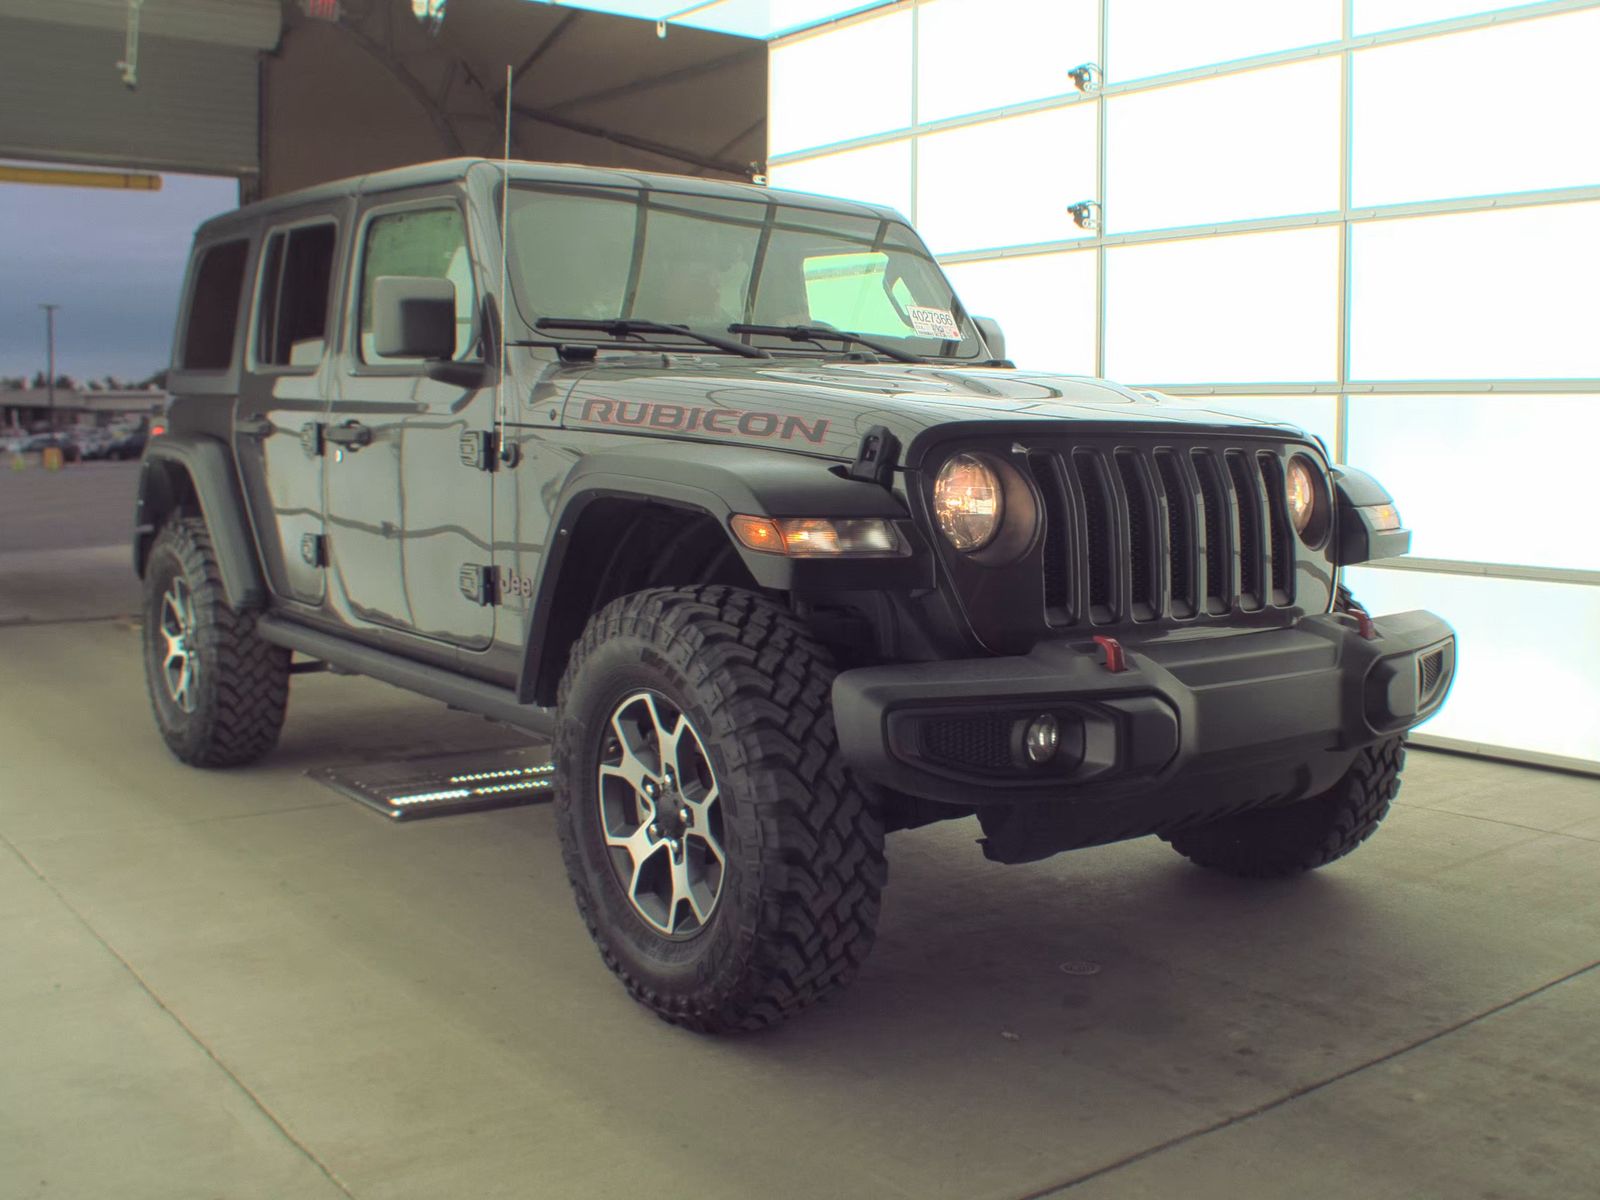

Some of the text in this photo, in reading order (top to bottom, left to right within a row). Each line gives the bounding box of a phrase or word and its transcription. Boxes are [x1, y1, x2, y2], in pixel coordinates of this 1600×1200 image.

[912, 310, 953, 326] 4027366
[581, 398, 830, 444] RUBICON
[501, 568, 533, 598] Jee
